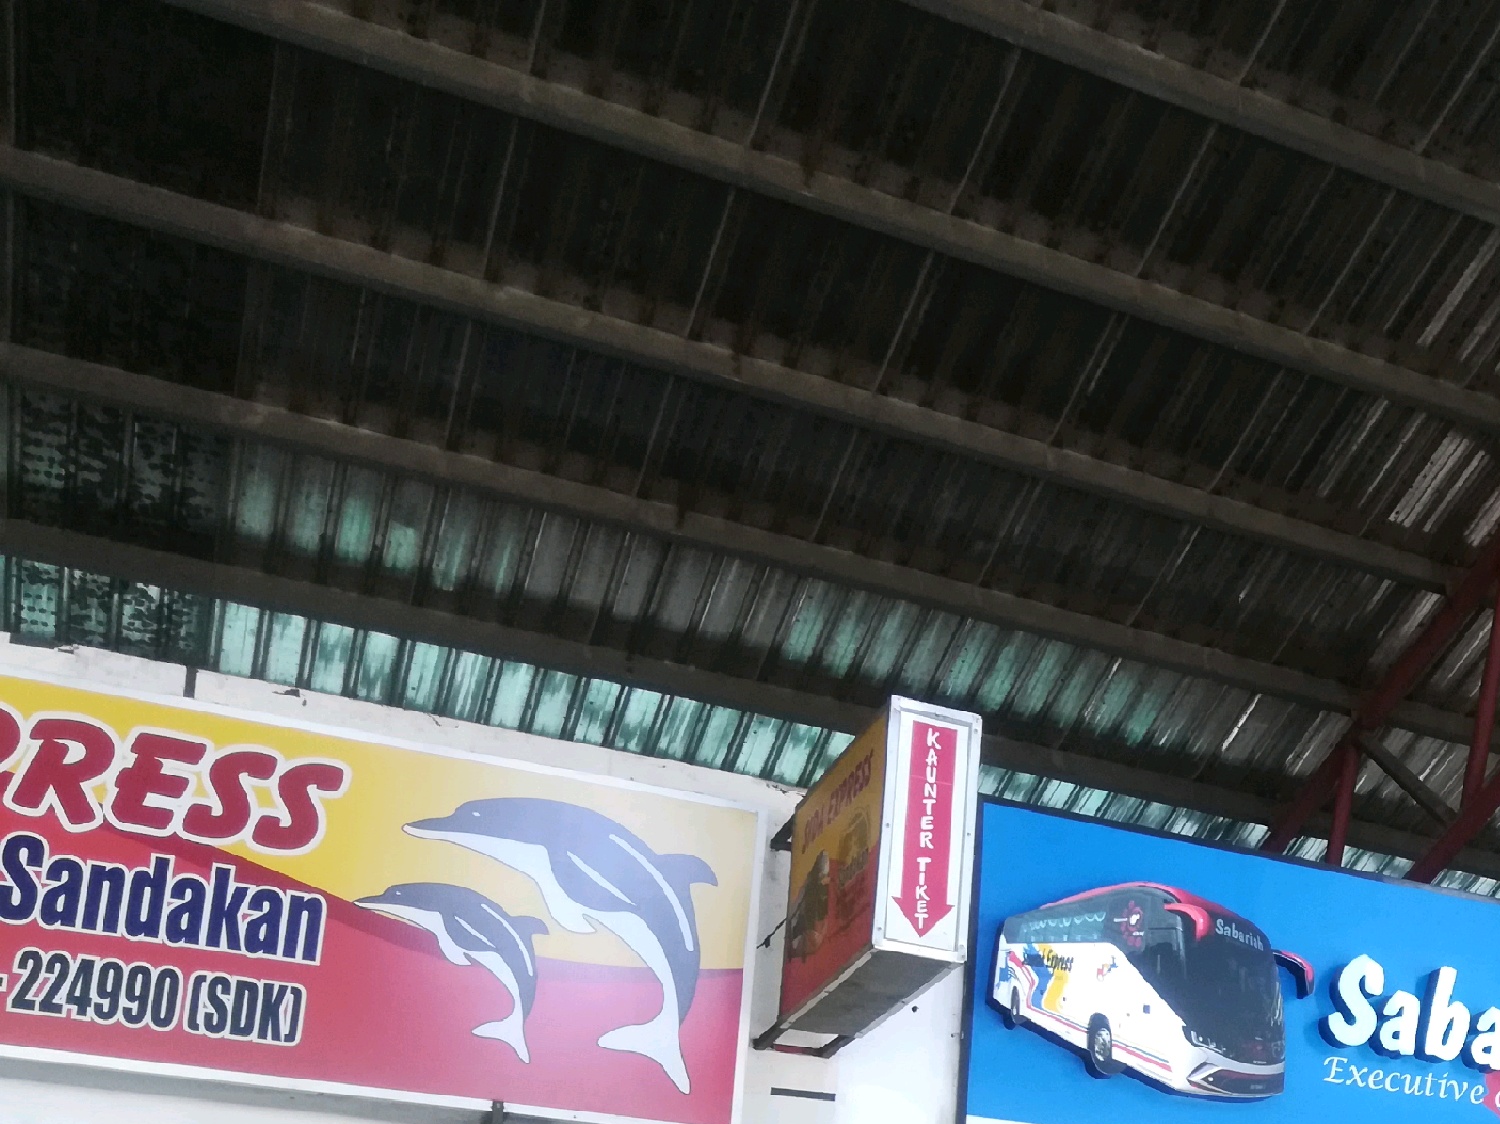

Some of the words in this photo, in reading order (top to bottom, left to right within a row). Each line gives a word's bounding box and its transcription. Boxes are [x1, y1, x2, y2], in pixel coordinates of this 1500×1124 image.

[0, 708, 346, 851] RESS
[919, 727, 941, 849] KAUNTER
[0, 833, 327, 964] Sandakan
[914, 857, 931, 929] TIKET
[1215, 918, 1264, 951] Sabariah
[8, 948, 182, 1030] 224990
[185, 972, 304, 1044] (SDK)
[1323, 1055, 1485, 1105] Executive
